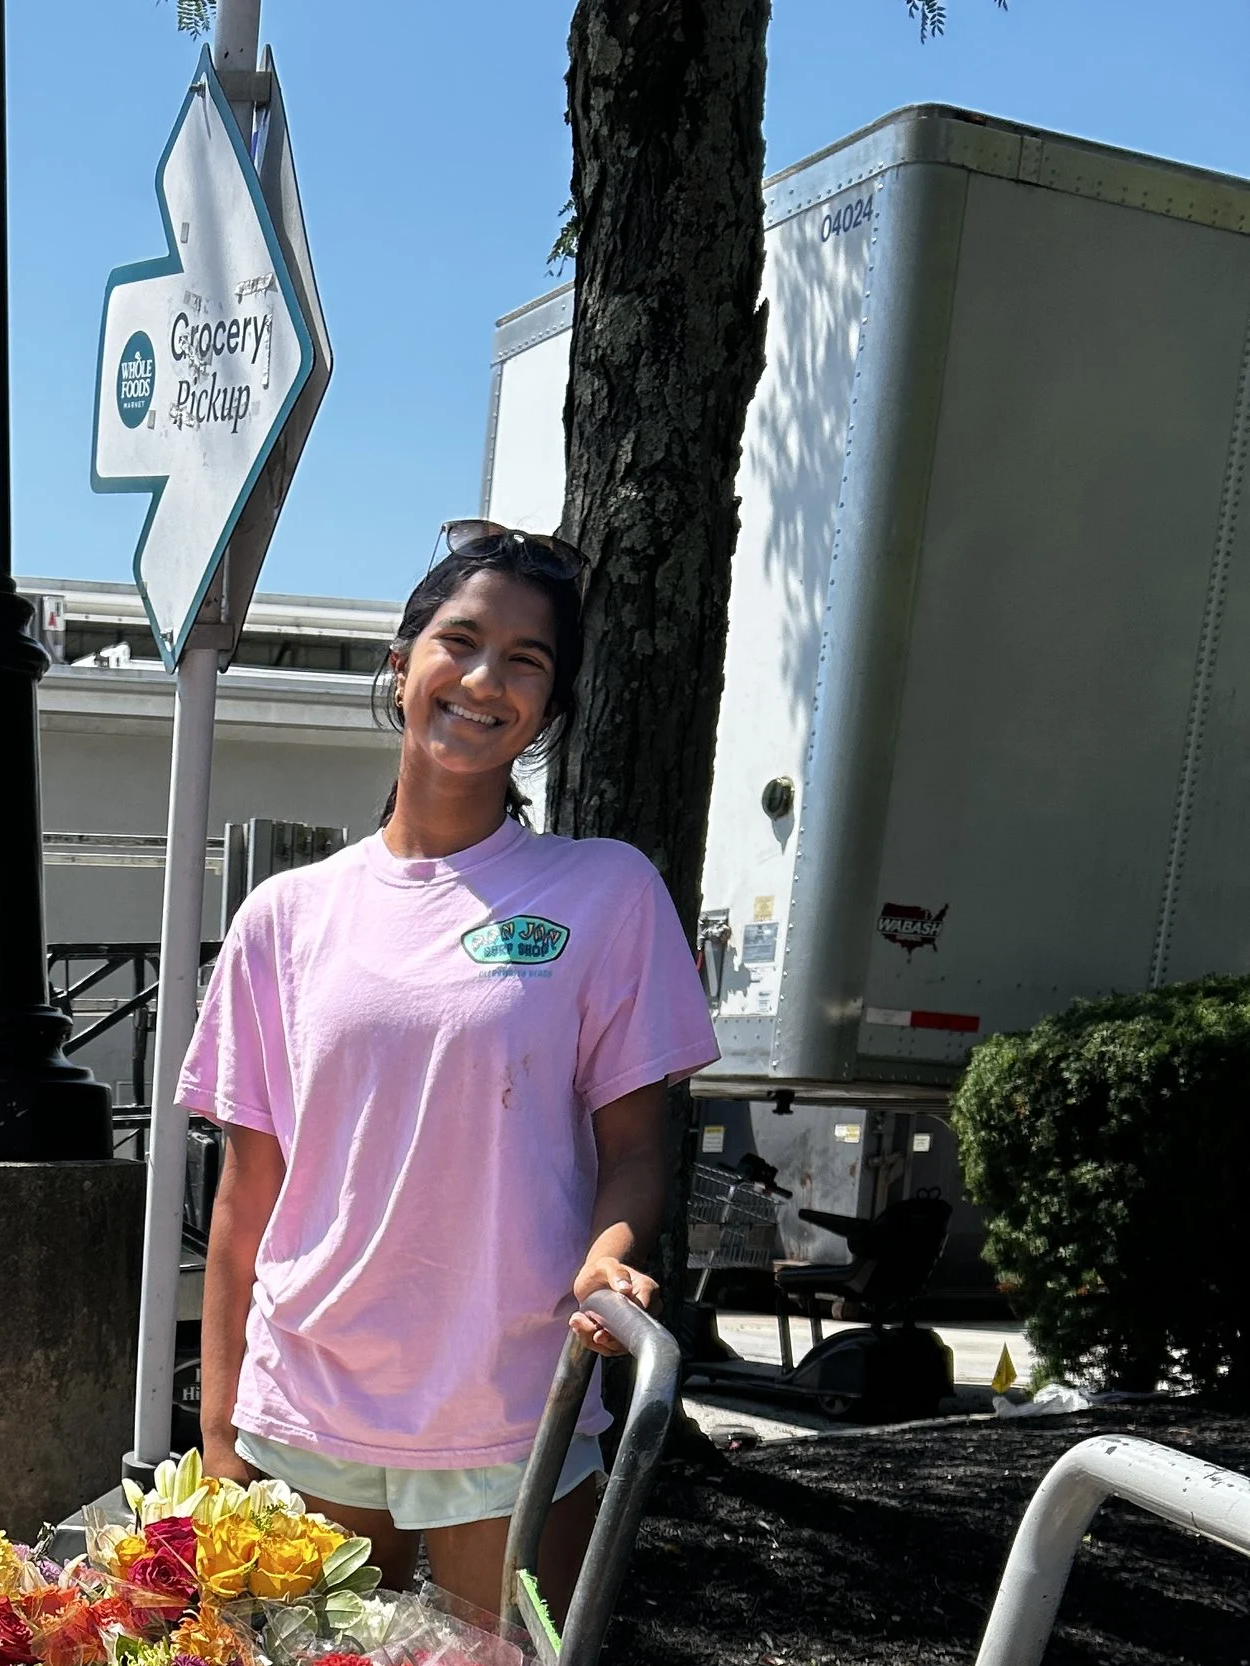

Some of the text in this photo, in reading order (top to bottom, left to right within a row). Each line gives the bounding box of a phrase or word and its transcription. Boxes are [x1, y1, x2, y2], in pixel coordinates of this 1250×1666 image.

[821, 195, 874, 242] 04024
[171, 312, 267, 363] Grocery
[121, 359, 153, 379] WHOLE
[121, 379, 151, 398] FOODS
[175, 372, 251, 434] Pickup
[878, 918, 942, 937] WABASH
[518, 943, 549, 957] SHOP
